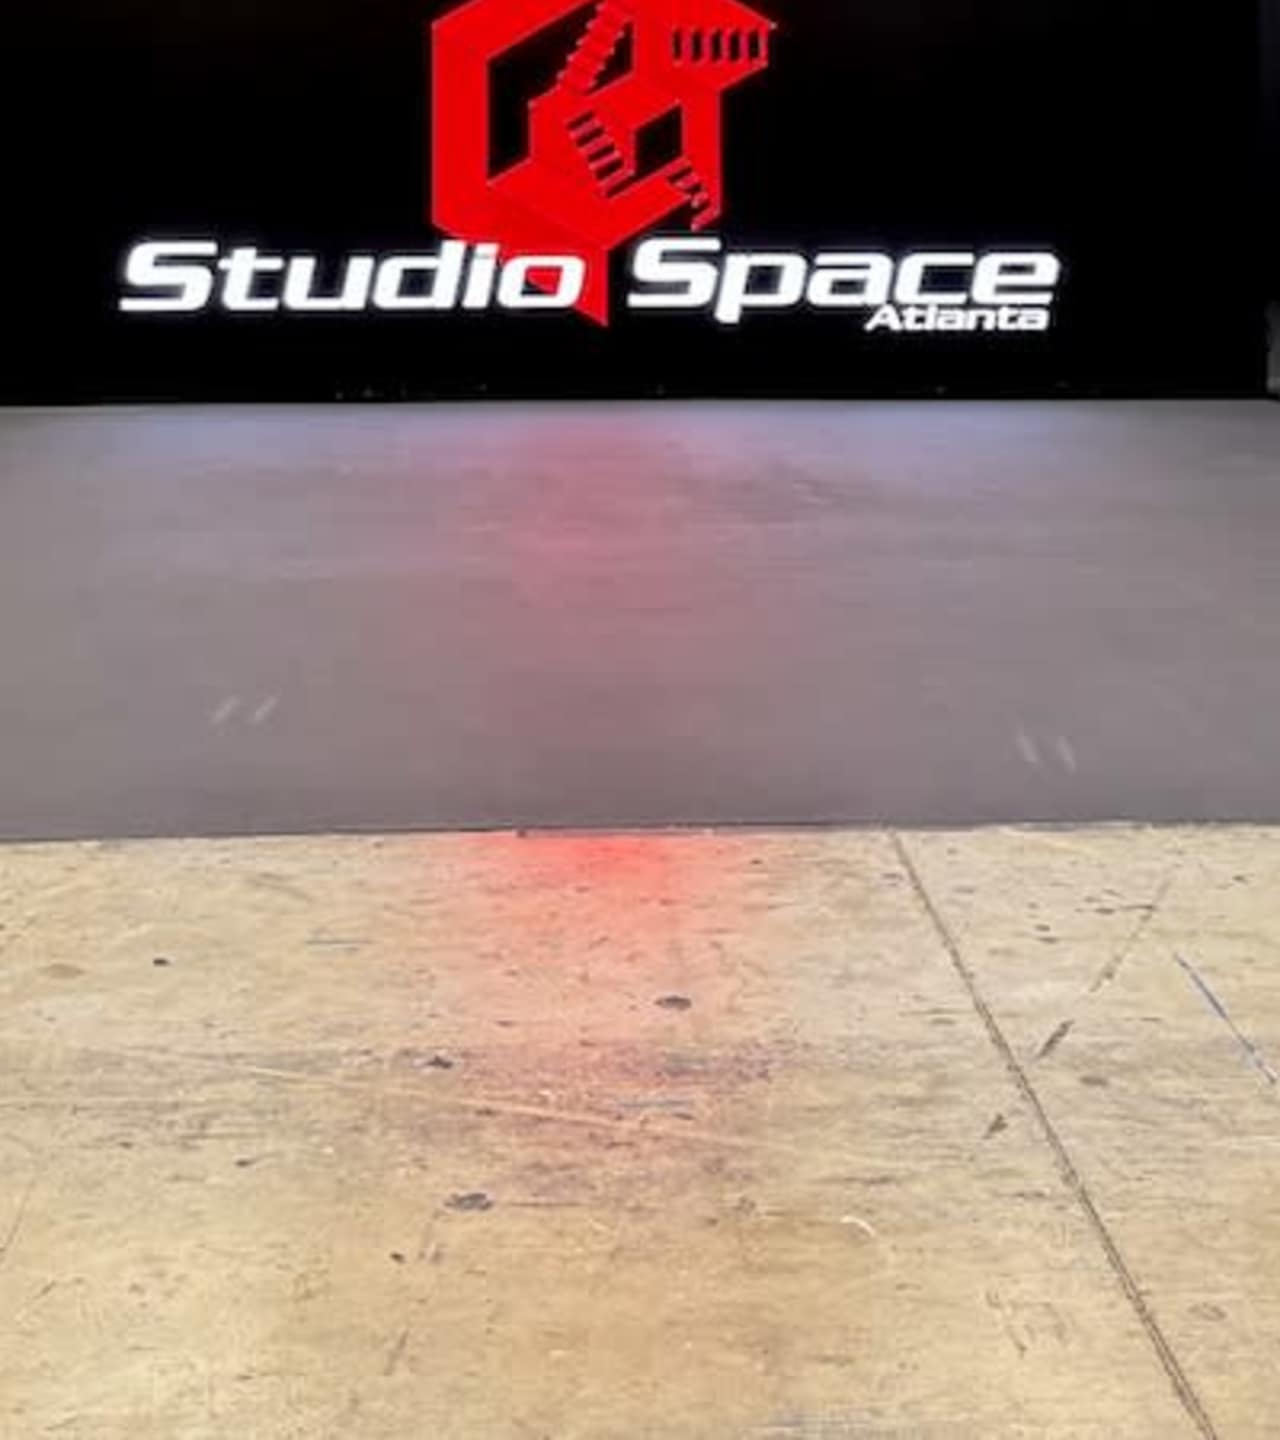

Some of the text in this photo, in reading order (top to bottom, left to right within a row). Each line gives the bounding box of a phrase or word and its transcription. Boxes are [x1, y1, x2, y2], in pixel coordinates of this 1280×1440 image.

[120, 236, 1060, 324] Studio Space
[864, 303, 1050, 332] Atlanta
